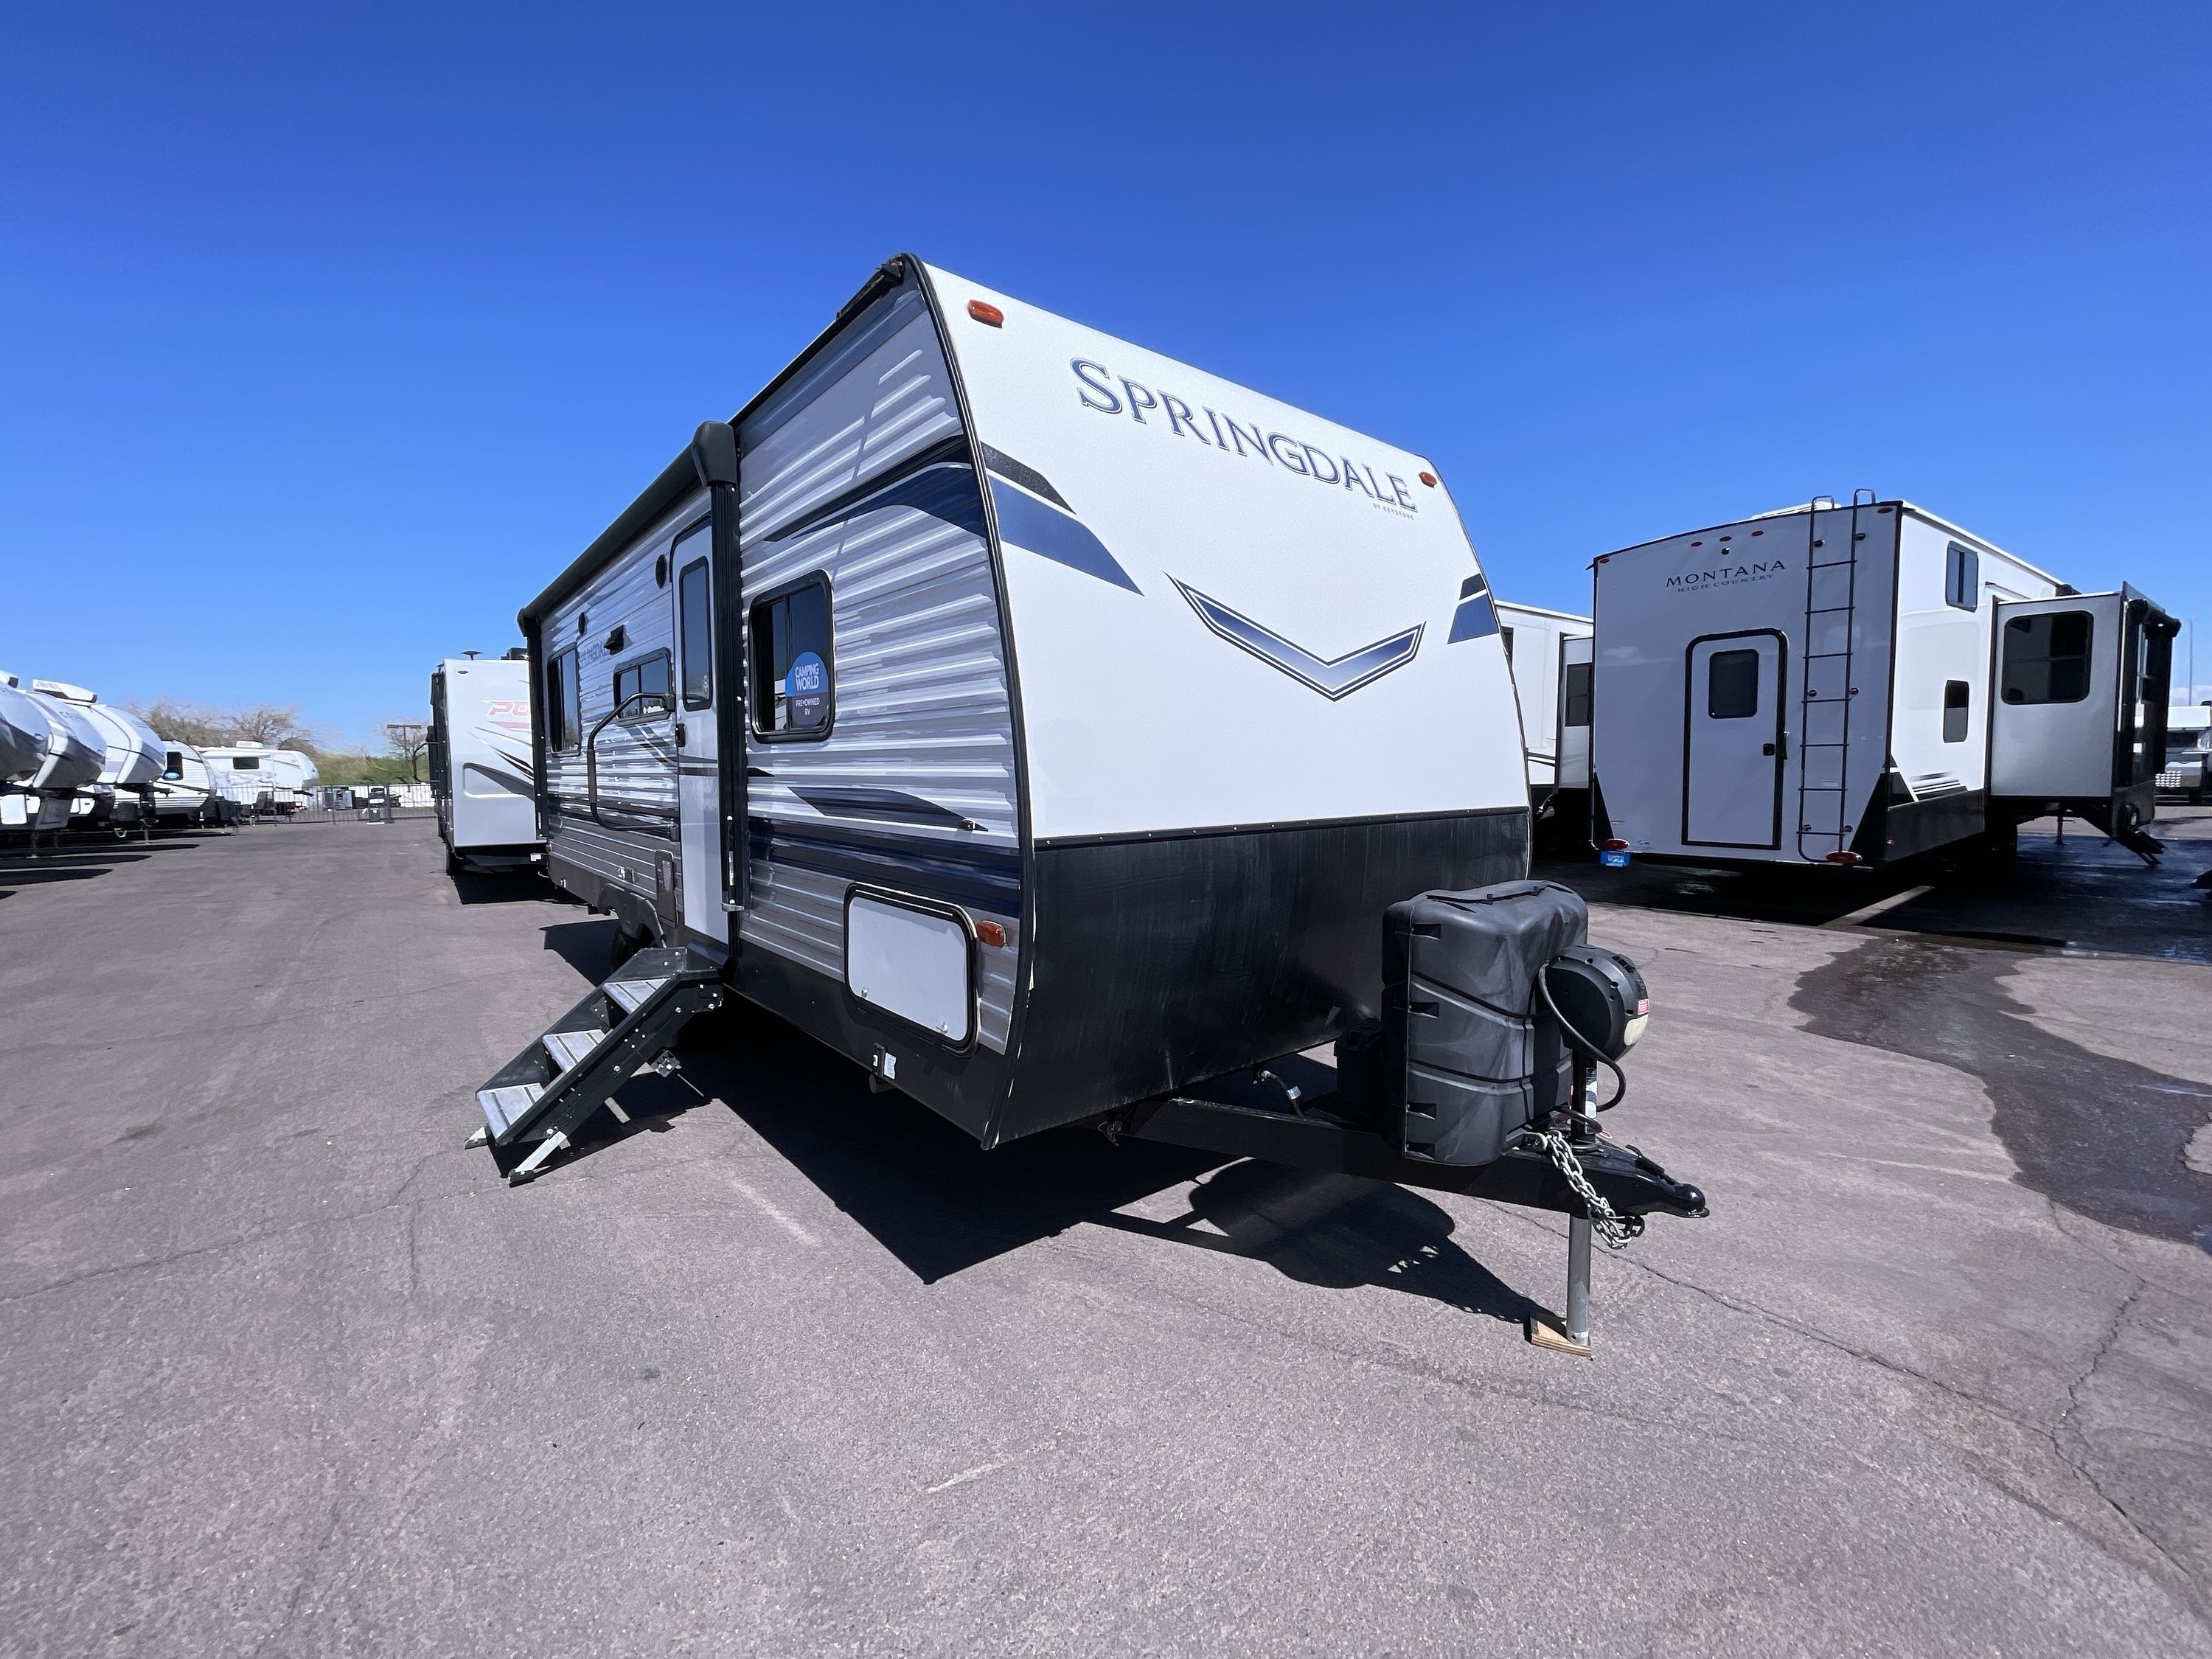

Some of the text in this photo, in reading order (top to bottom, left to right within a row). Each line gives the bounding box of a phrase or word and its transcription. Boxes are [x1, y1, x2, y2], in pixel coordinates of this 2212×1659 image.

[1069, 357, 1418, 512] SPRINGDALE
[1666, 560, 1786, 587] MONTANA
[1677, 574, 1775, 592] HIGH COUNTRY
[796, 663, 819, 678] CAMPING
[796, 675, 819, 691] WORLD
[804, 708, 810, 716] RV
